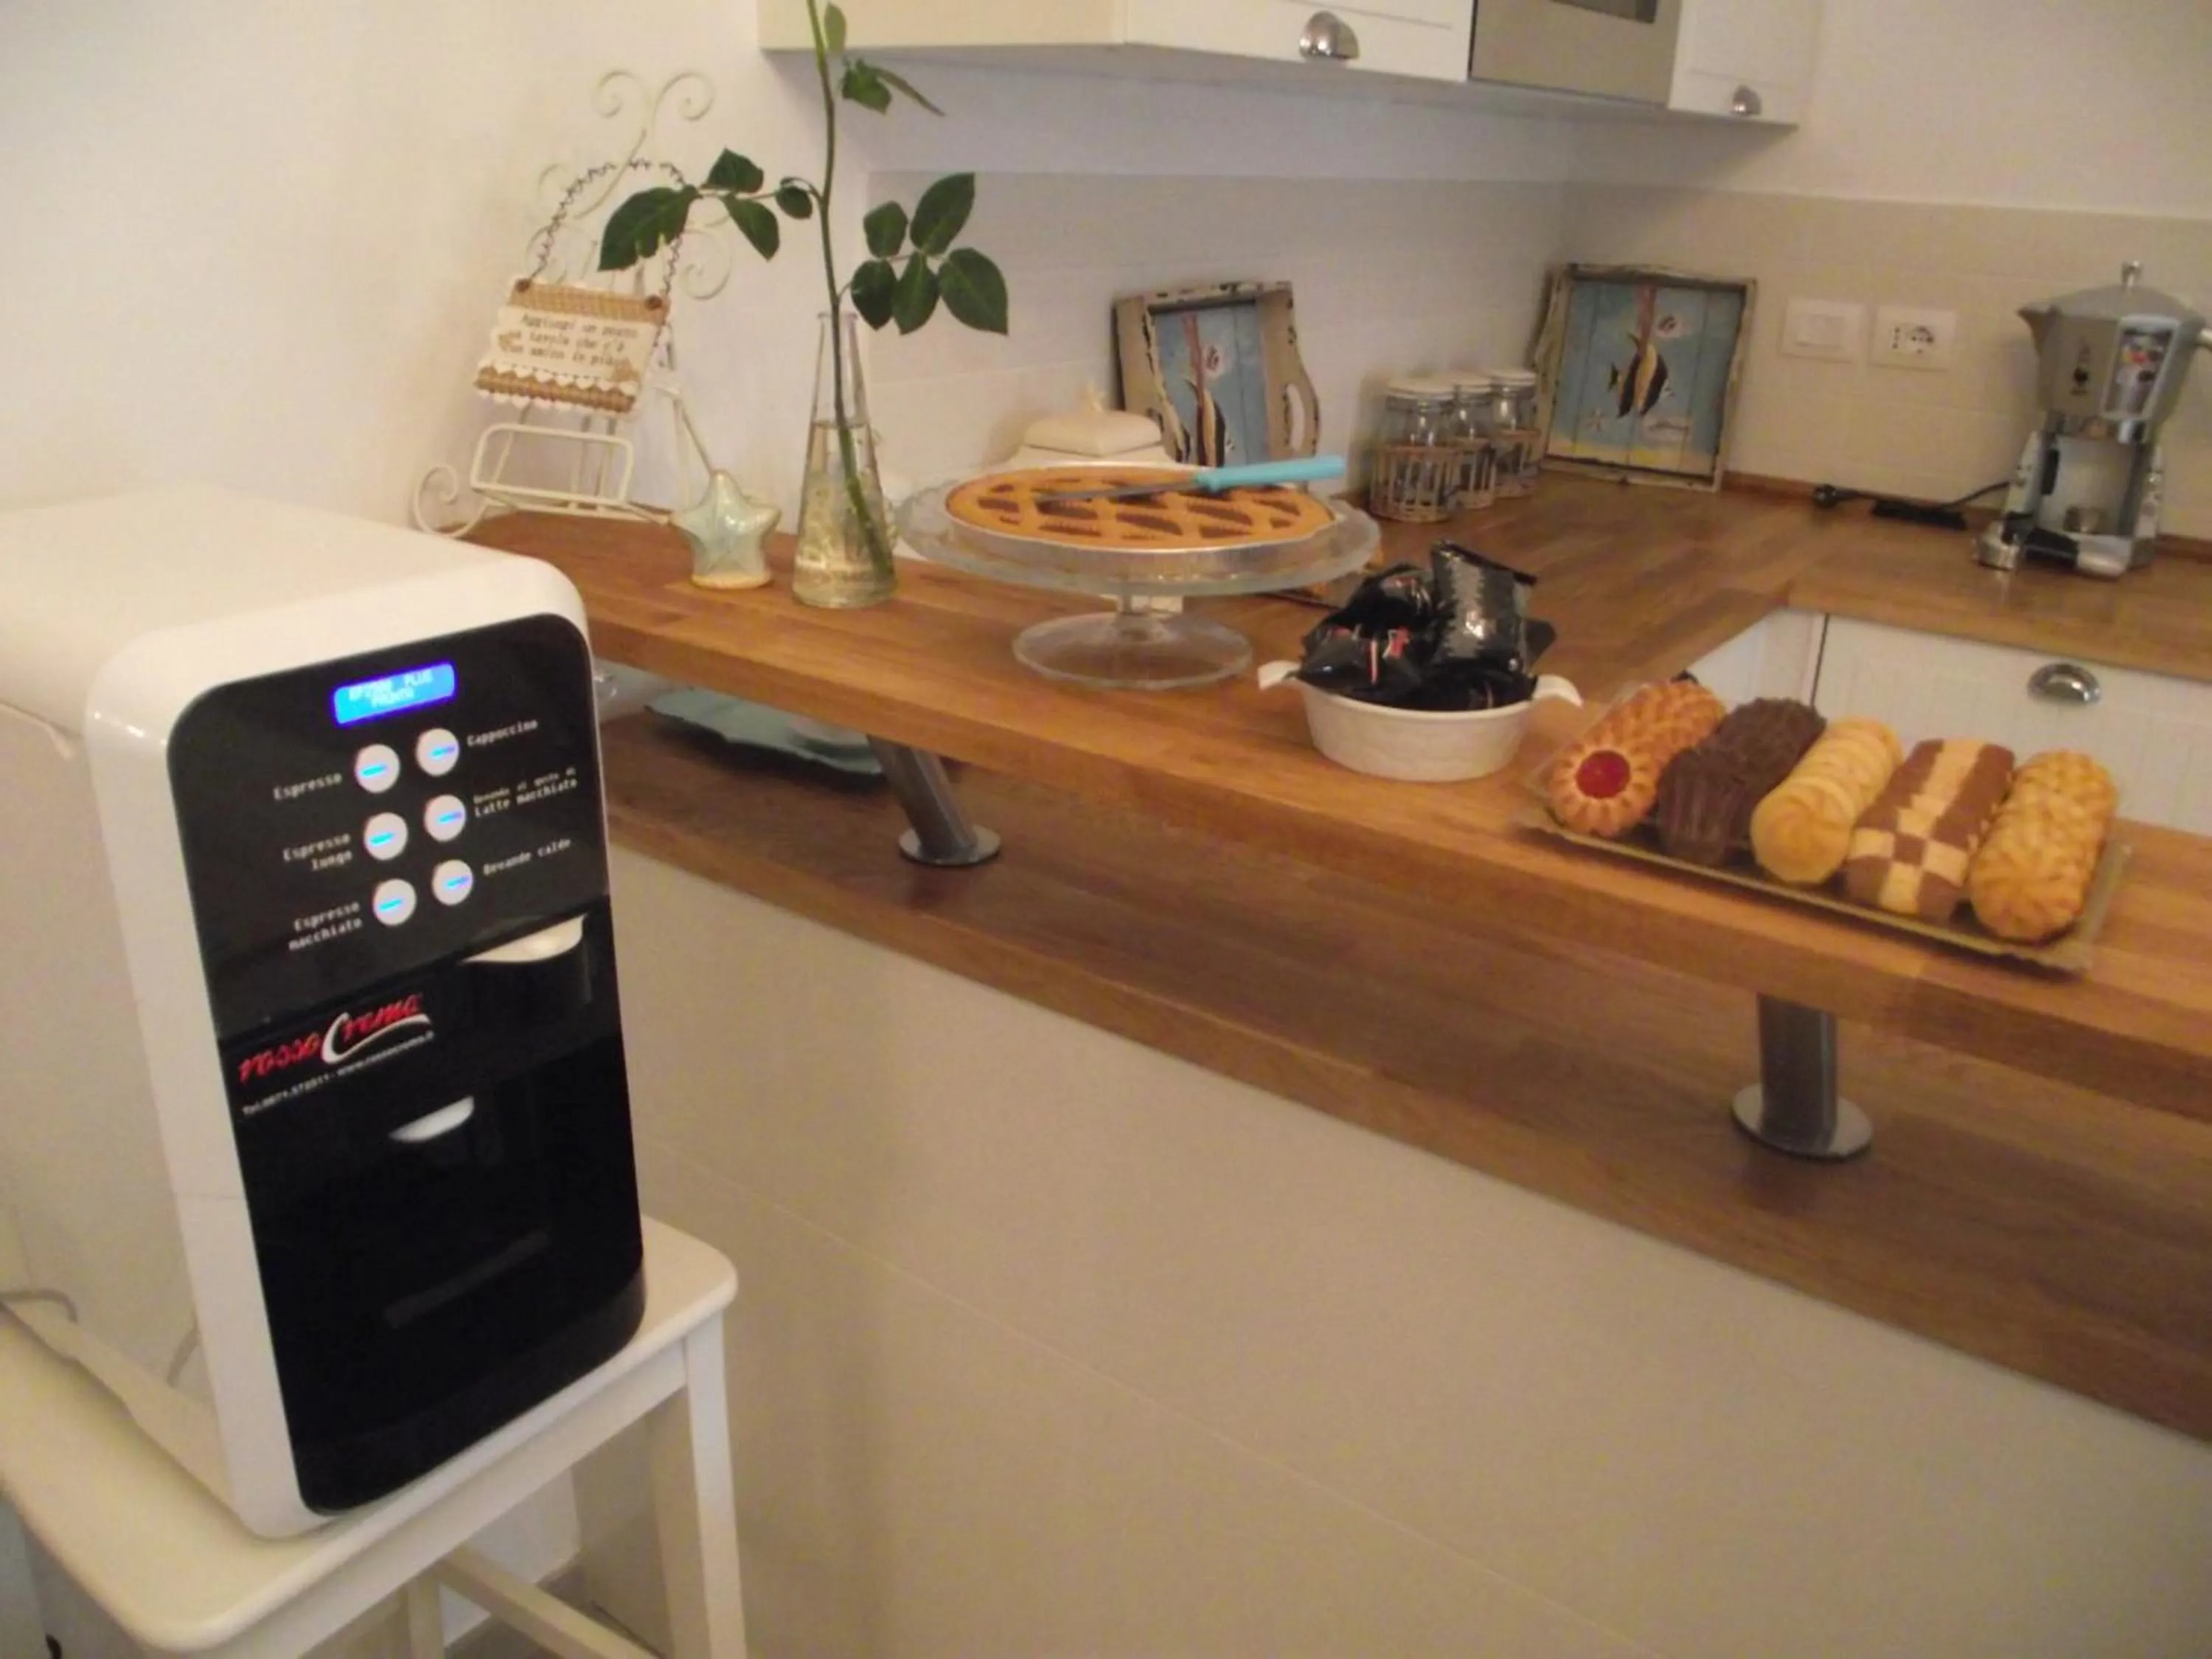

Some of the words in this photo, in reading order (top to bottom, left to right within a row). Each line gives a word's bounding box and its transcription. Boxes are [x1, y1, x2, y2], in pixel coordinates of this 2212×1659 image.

[467, 719, 539, 747] Cappuccino
[273, 772, 343, 801] Espresso
[474, 798, 511, 818] Latte
[516, 778, 578, 806] macchiato
[283, 832, 351, 863] Espresso
[311, 849, 353, 872] lungo
[538, 838, 571, 858] calde
[293, 901, 361, 932] Espresso
[288, 918, 363, 952] macchiato
